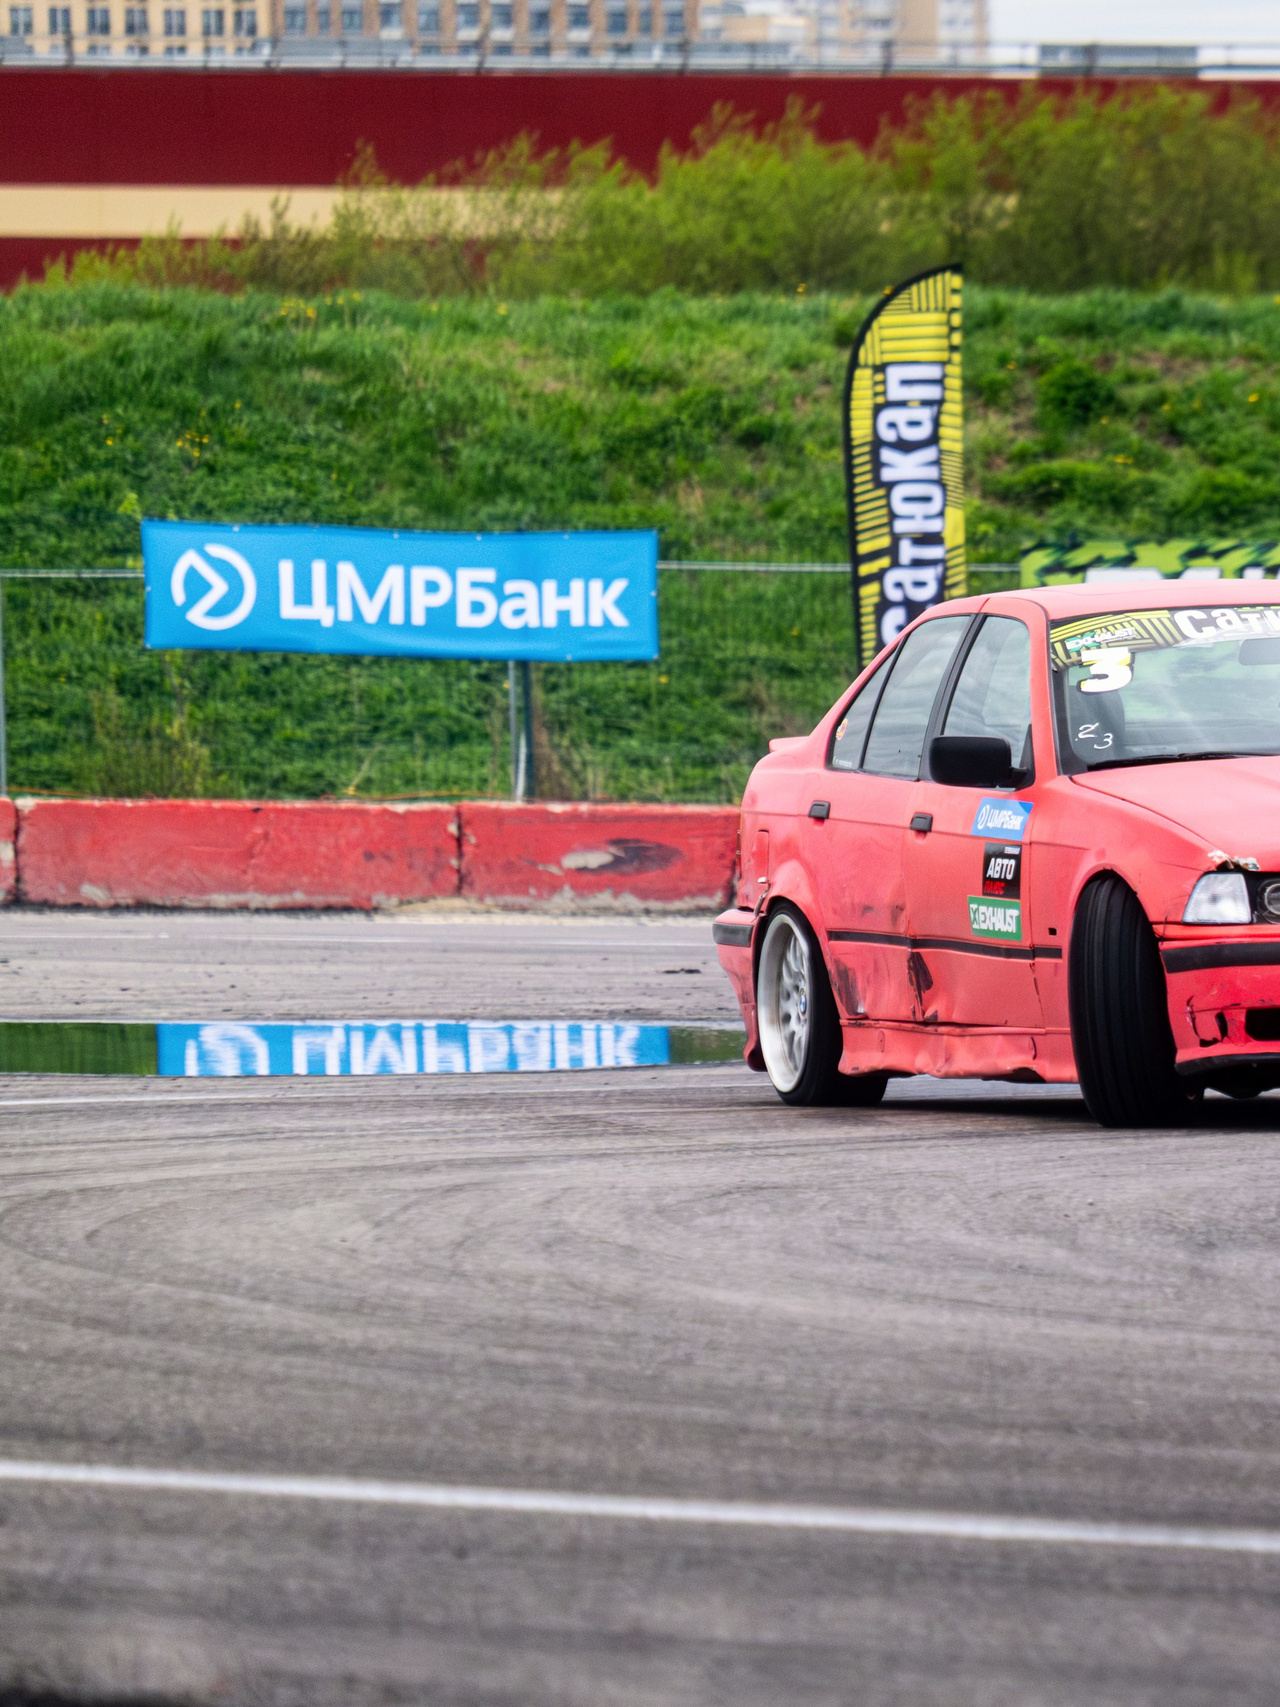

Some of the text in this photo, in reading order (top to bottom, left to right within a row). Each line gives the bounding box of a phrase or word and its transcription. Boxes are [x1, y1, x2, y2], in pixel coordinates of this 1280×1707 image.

[277, 558, 631, 629] ЦМРБанк
[1065, 626, 1137, 651] EXHAUST
[1080, 646, 1133, 693] 3
[986, 808, 1025, 831] ЦМРБанк
[986, 857, 1016, 880] АВТО
[978, 905, 1020, 933] EXHAUST
